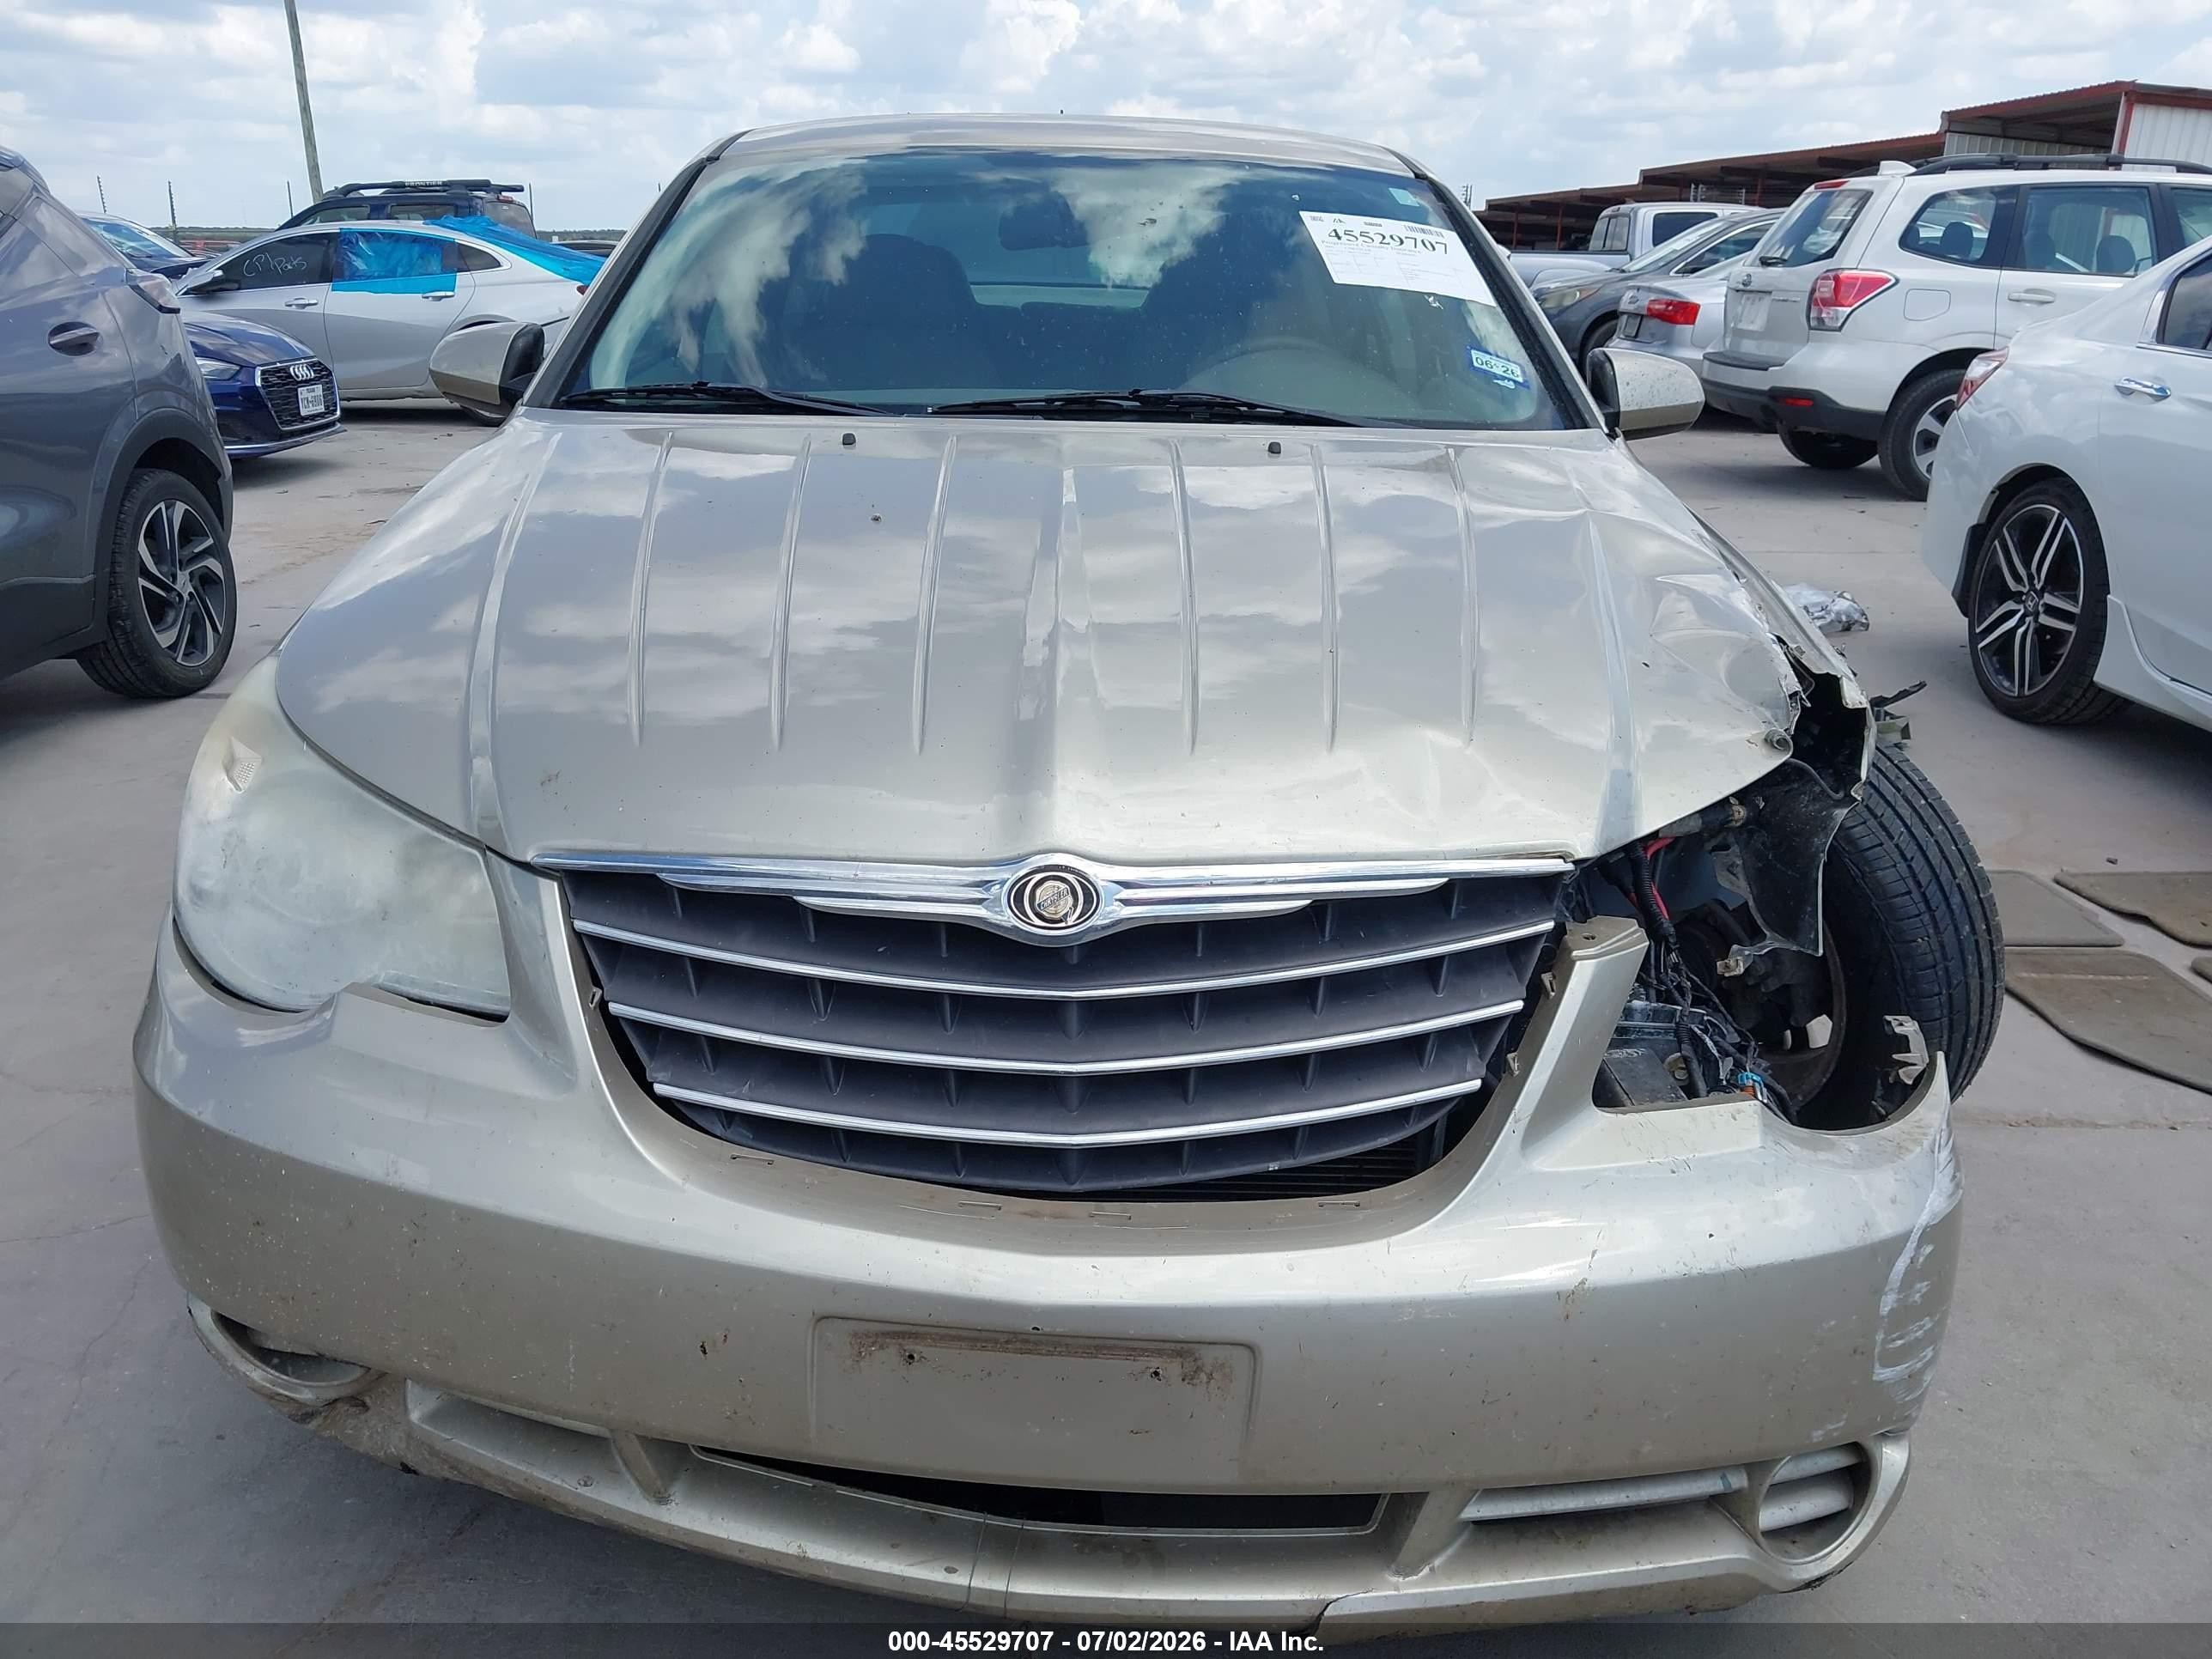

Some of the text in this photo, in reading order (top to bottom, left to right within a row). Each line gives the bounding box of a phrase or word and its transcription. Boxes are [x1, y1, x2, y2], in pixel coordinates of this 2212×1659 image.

[1328, 228, 1449, 255] 45529707
[1474, 356, 1520, 379] 06 26
[1040, 888, 1068, 910] CHRYSLER
